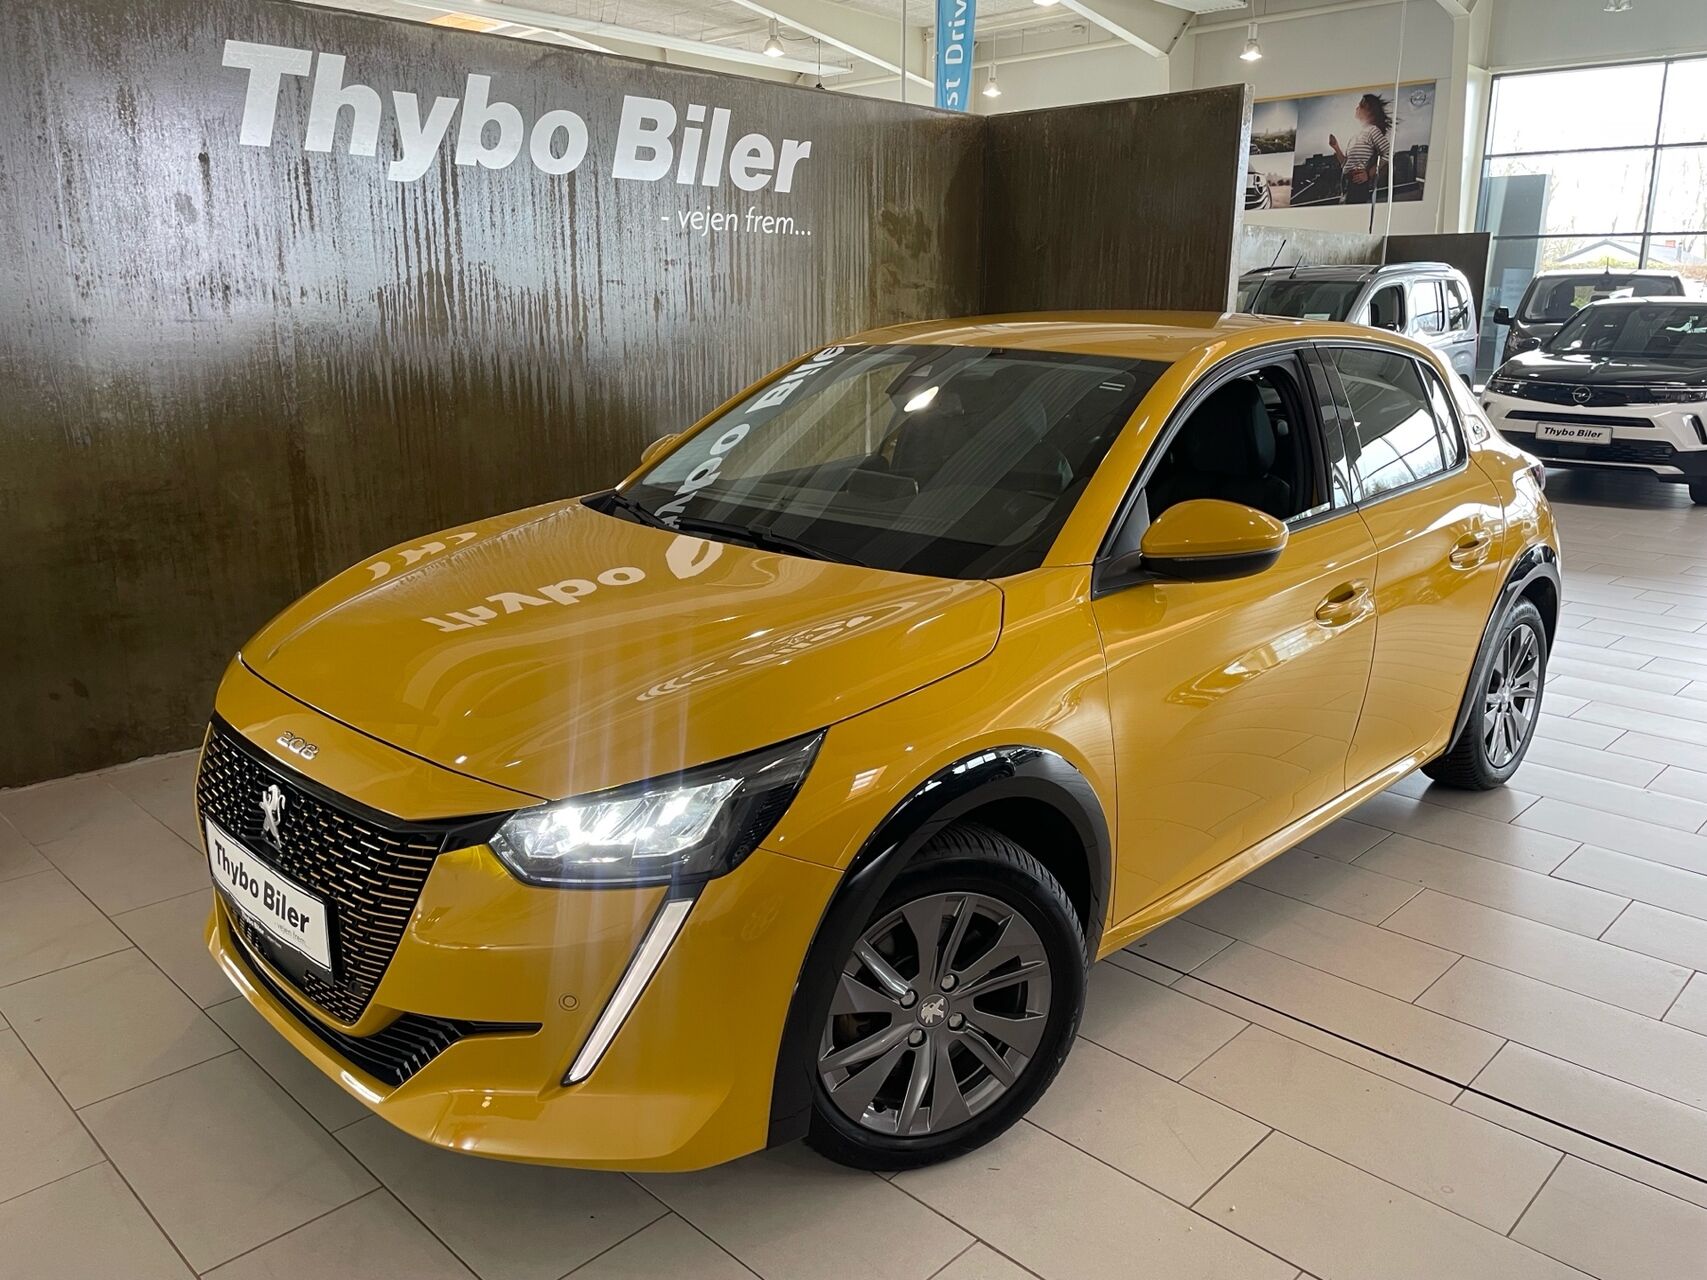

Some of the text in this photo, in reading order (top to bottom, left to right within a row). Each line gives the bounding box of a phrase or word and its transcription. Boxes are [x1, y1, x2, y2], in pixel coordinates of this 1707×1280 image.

[945, 78, 961, 111] st
[221, 39, 813, 193] Thybo Biler
[678, 205, 739, 237] vejen
[745, 206, 812, 236] frem...
[1544, 427, 1603, 438] Thybo Biler
[276, 731, 320, 760] 208
[214, 839, 259, 898] Thybo
[263, 880, 310, 933] Biler
